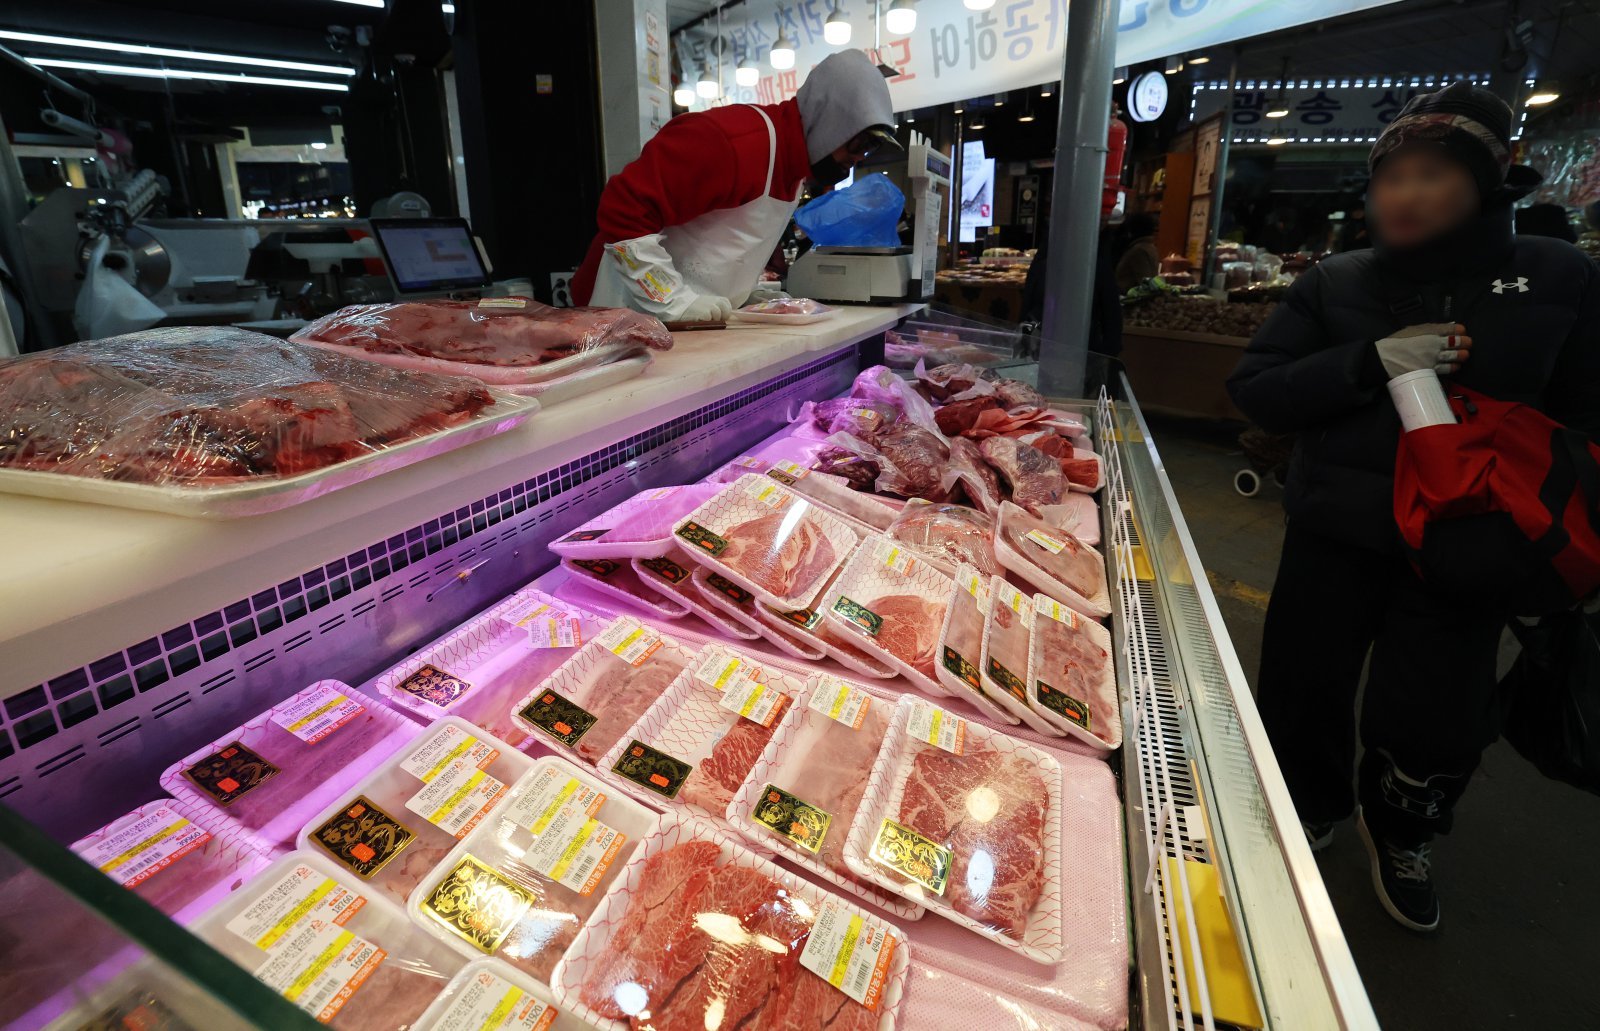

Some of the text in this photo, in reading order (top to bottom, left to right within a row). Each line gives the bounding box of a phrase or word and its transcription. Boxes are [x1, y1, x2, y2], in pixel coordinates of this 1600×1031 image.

[483, 783, 501, 799] 20160
[175, 830, 201, 847] 39960
[598, 831, 614, 850] 22320
[580, 861, 607, 895] 우아농장
[330, 894, 354, 913] 18760
[870, 931, 883, 953] 49410
[349, 946, 373, 969] 16080
[864, 966, 883, 1008] 우아농장
[520, 1004, 544, 1029] 31920
